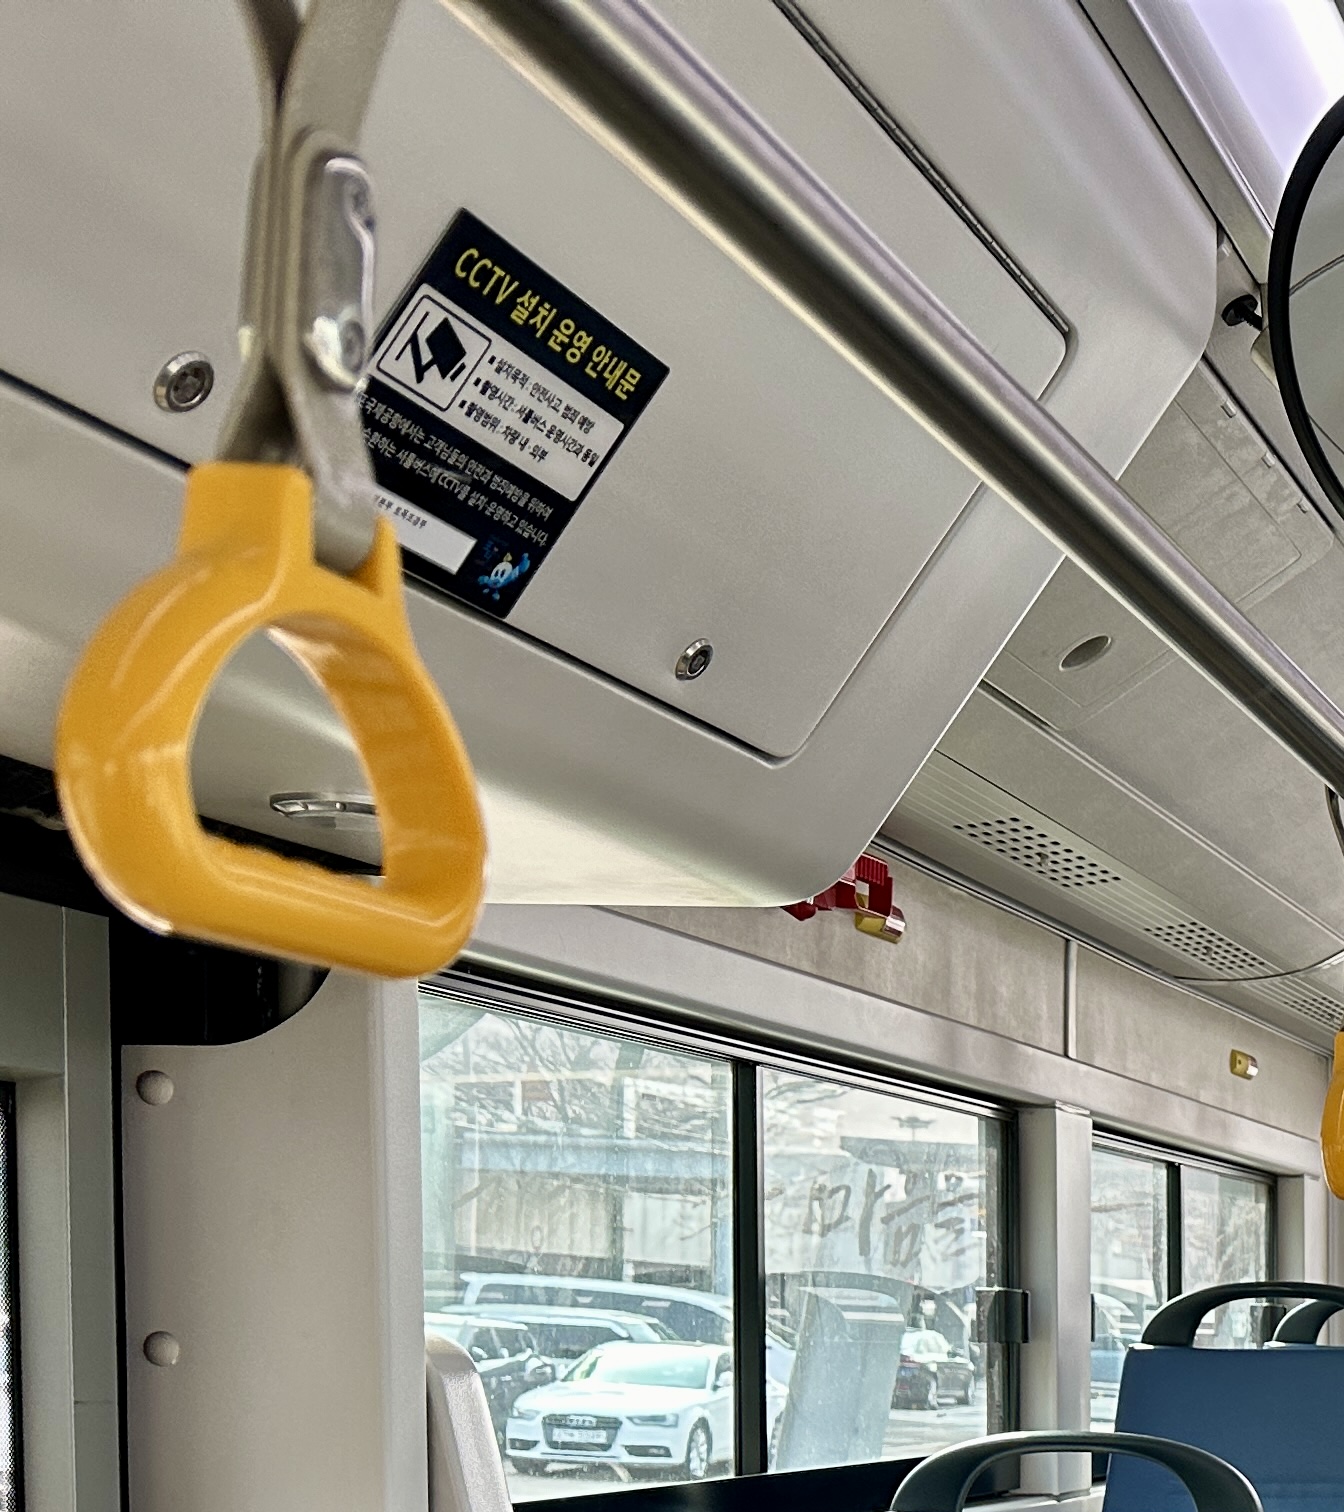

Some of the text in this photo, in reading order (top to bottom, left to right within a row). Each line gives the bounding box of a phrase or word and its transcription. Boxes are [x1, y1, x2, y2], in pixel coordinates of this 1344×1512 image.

[455, 248, 641, 400] CCTV 설치 운영 안내문
